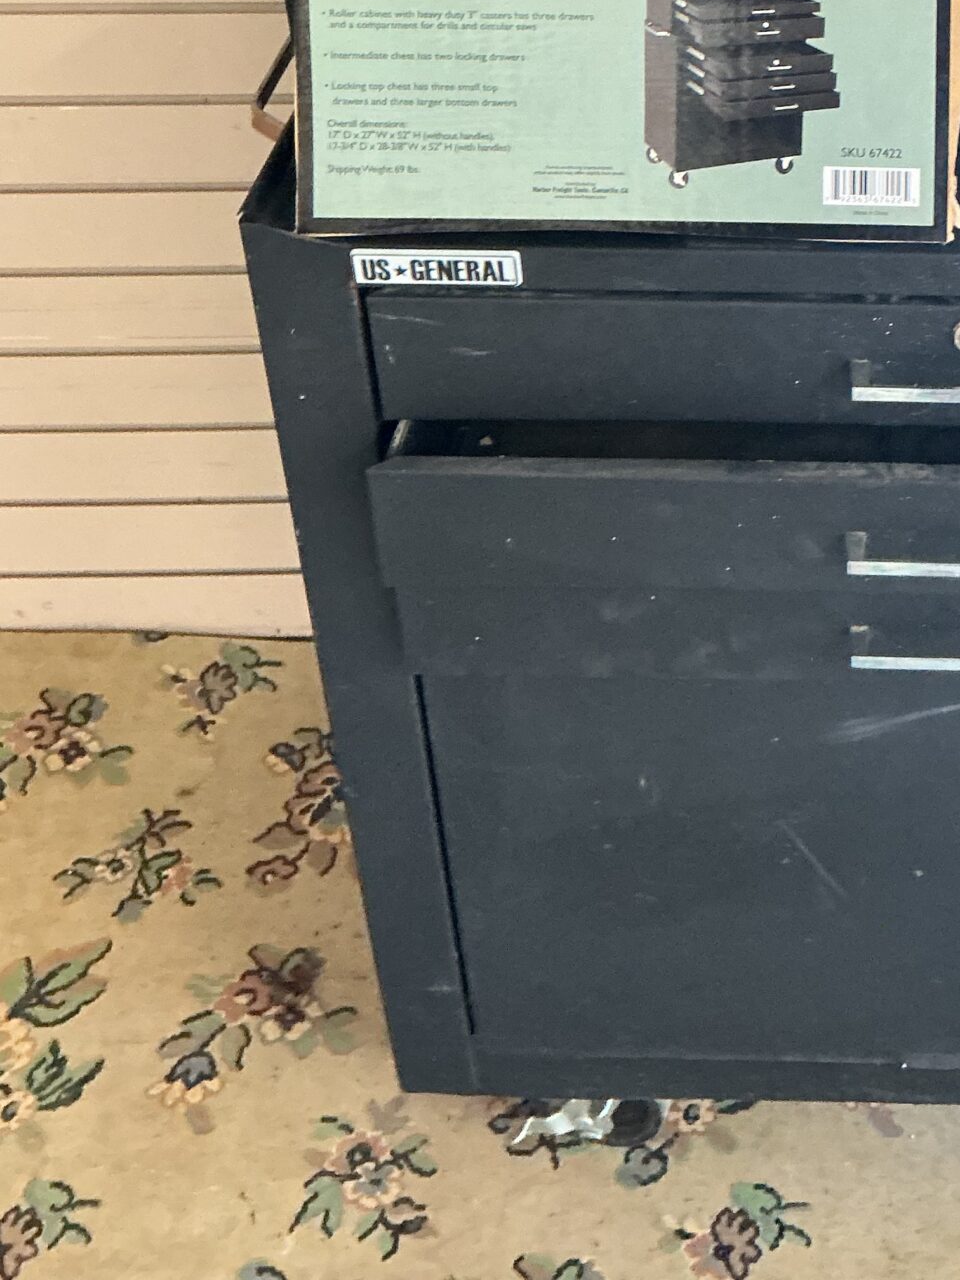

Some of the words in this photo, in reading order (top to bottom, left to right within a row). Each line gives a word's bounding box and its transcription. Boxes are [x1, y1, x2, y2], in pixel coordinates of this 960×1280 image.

[840, 147, 866, 158] SKU
[869, 148, 902, 159] 67422
[361, 259, 391, 281] US
[410, 260, 511, 282] GENERAL
